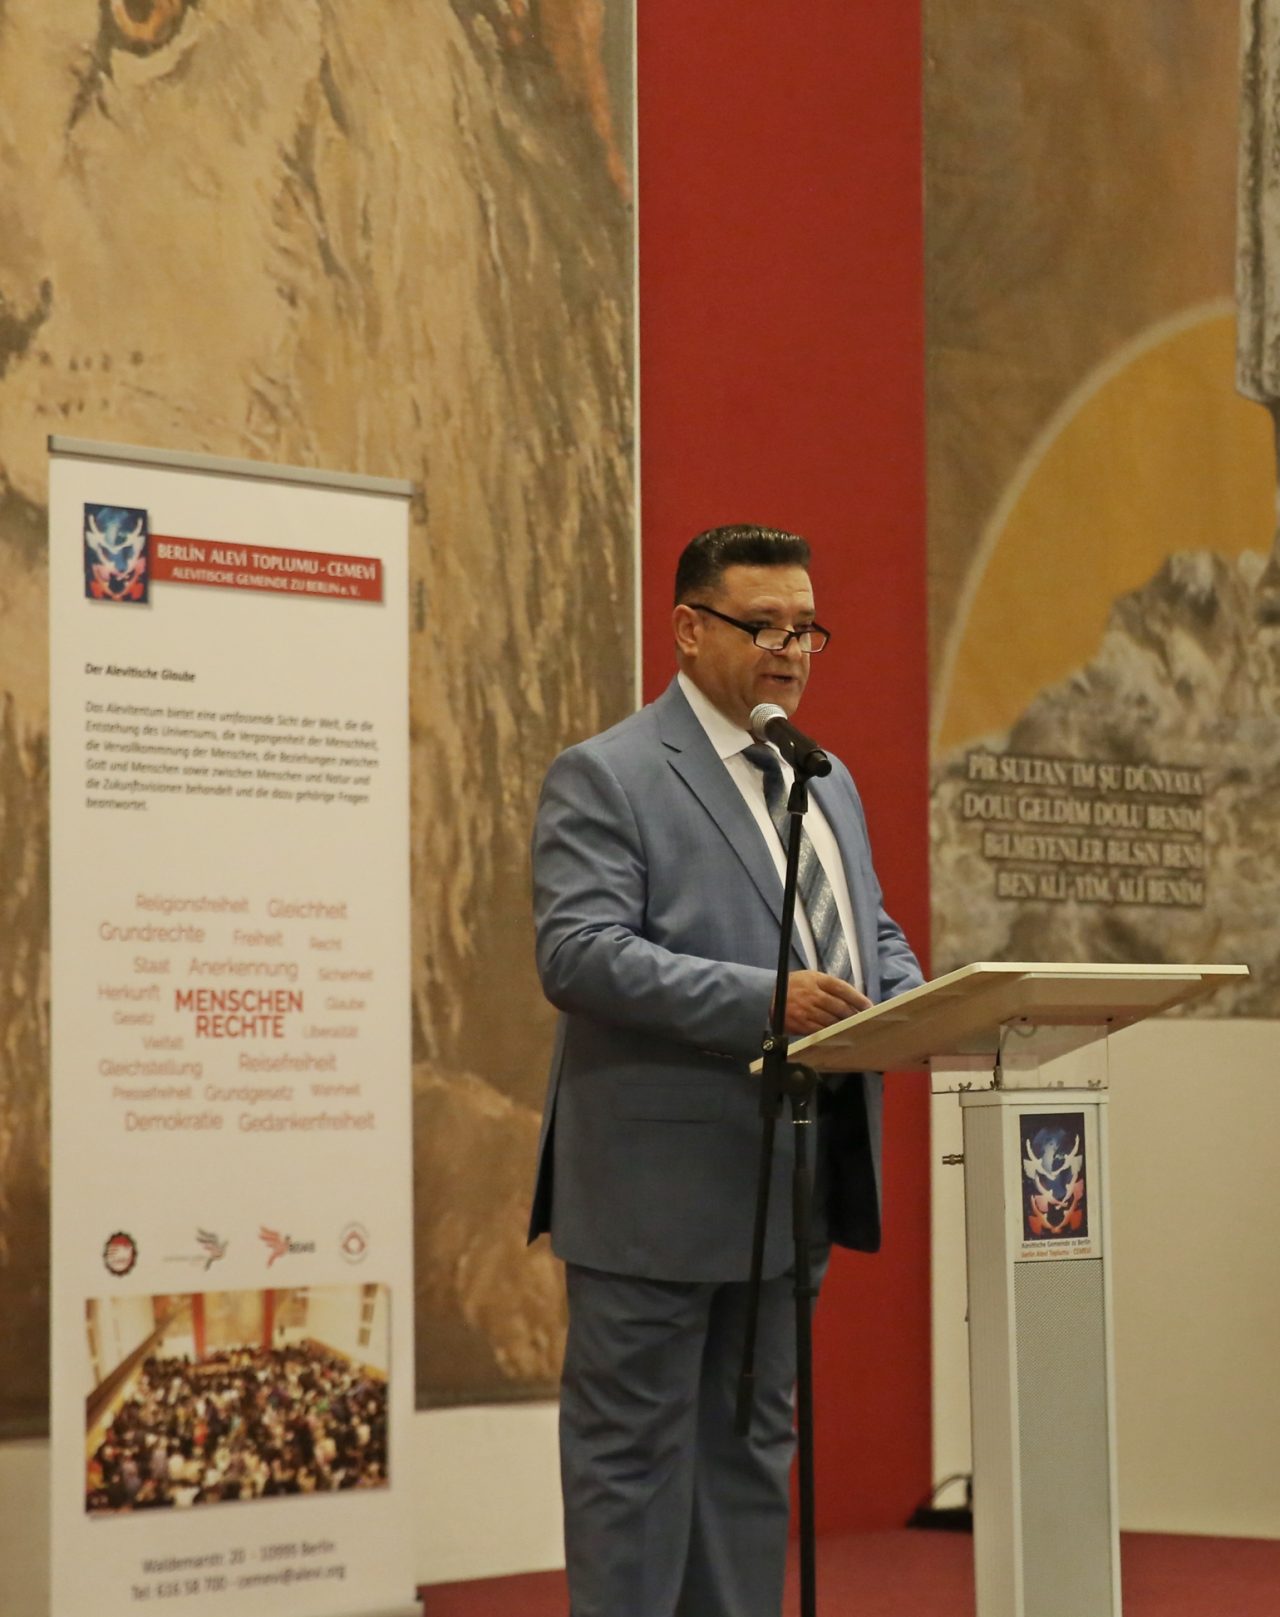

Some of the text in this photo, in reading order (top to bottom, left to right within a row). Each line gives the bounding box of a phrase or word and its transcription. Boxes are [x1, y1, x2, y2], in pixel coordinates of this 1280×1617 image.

[209, 548, 247, 567] ALEVİ
[252, 553, 318, 574] TOPLUMU
[236, 573, 288, 590] GEMEINDE
[306, 578, 341, 595] BERLIN
[85, 663, 102, 675] Der
[161, 669, 196, 683] Glaube
[963, 792, 1015, 820] DOLU
[267, 898, 348, 919] Gleichheit
[98, 921, 205, 943] Grundrechte
[233, 929, 283, 948] Freiheit
[188, 957, 299, 982] Anerkennung
[175, 988, 304, 1013] MENSCHEN
[196, 1014, 286, 1038] RECHTE
[124, 1110, 224, 1132] Demokratie
[301, 1539, 336, 1556] Berlin
